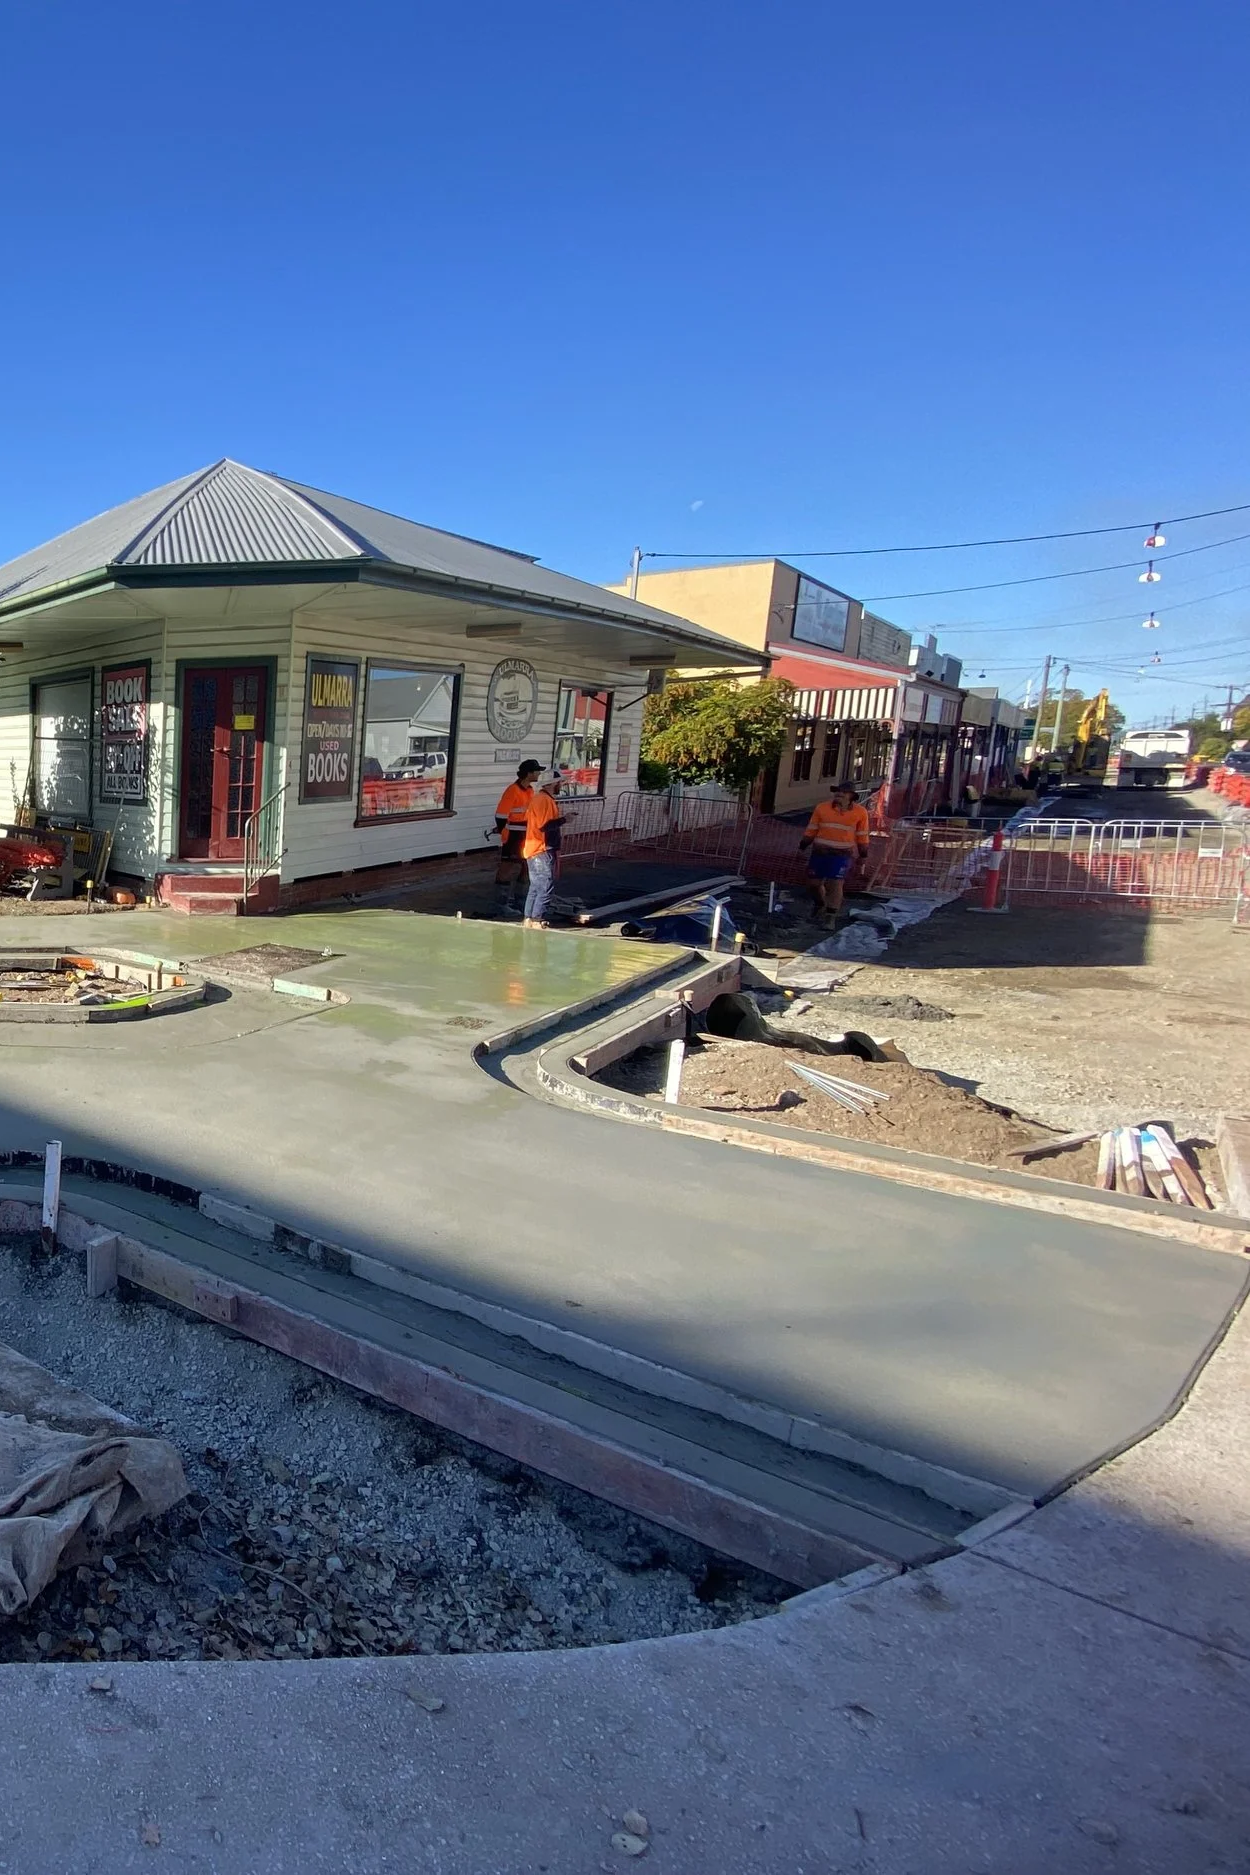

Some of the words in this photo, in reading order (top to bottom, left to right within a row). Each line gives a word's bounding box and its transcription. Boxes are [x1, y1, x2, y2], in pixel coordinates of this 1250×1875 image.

[499, 660, 535, 682] ULMARRA
[106, 676, 143, 704] BOOK
[312, 673, 353, 707] ULMARRA
[307, 723, 322, 738] OPEN
[321, 721, 327, 738] 7
[325, 723, 339, 738] DAYS
[320, 741, 339, 751] USED
[307, 753, 348, 782] BOOKS
[107, 775, 117, 789] ALL
